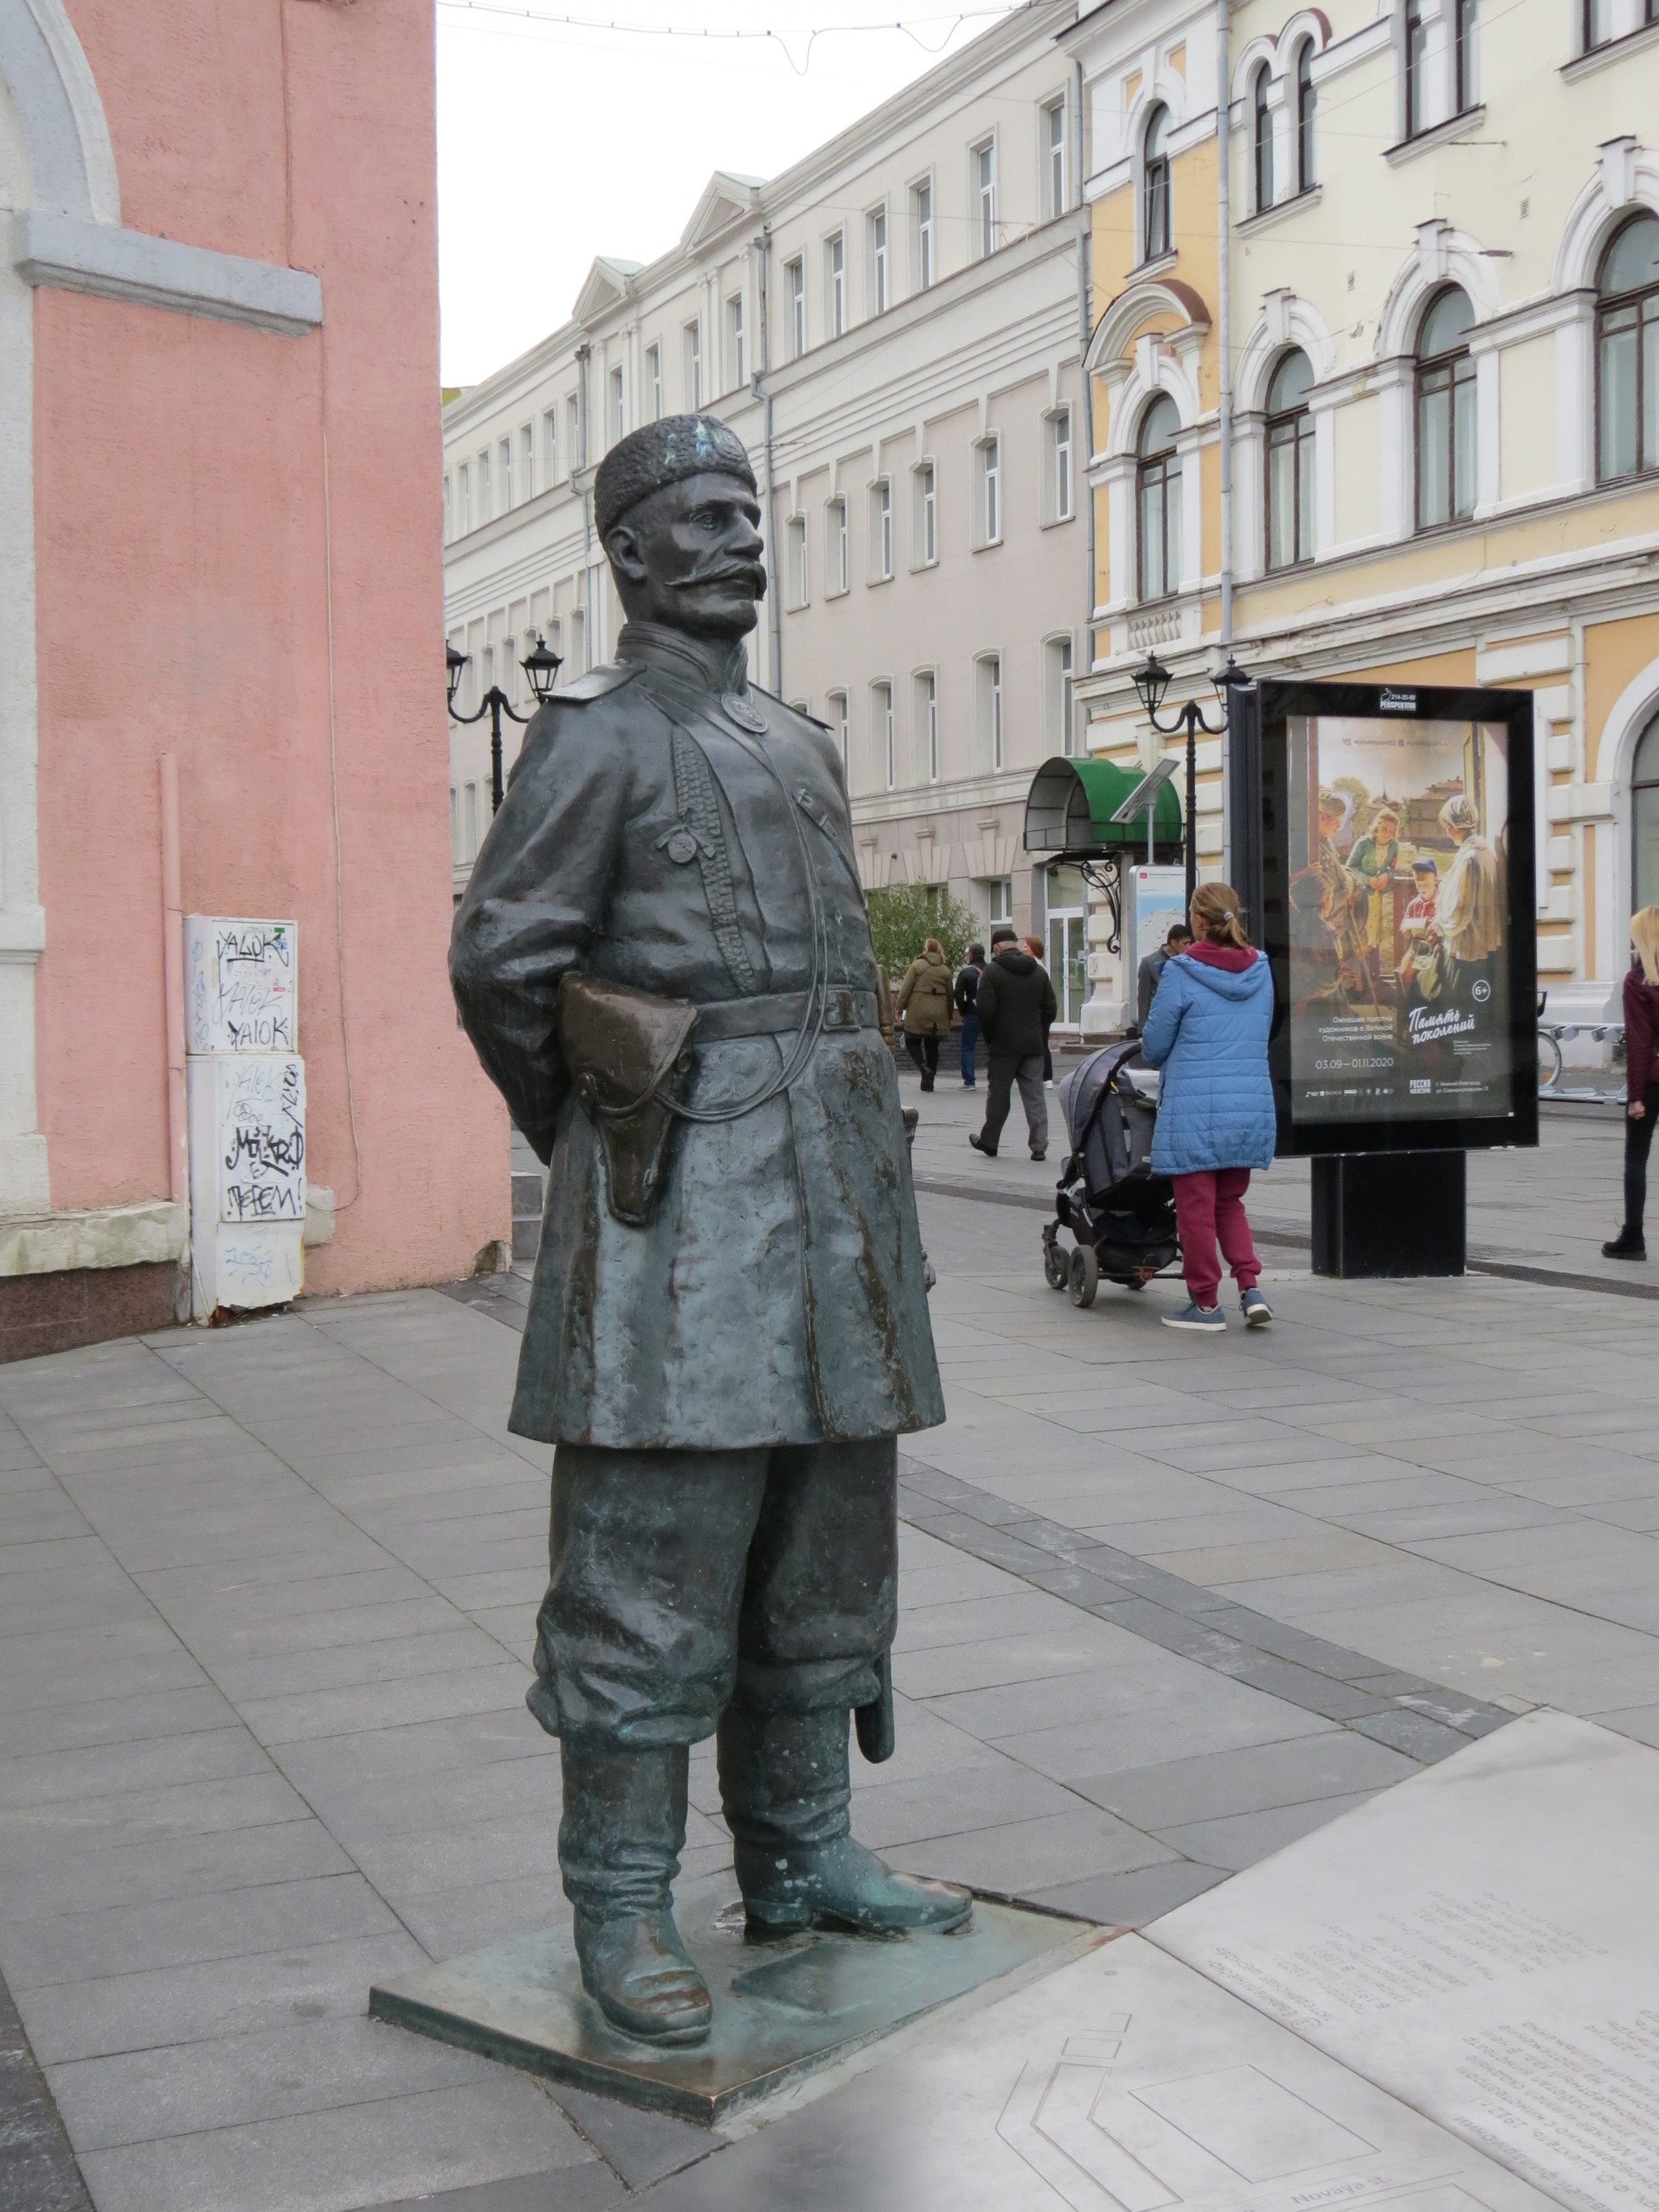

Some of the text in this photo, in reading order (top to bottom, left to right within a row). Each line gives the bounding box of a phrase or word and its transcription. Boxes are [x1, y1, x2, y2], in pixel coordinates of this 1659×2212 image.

[1318, 1025, 1358, 1034] художников
[1366, 1024, 1393, 1032] Великой
[1333, 1016, 1393, 1025] Ожившие полотна
[1409, 1007, 1461, 1033] Память
[1412, 1013, 1475, 1045] поколений
[1322, 1033, 1393, 1042] Отечественной войне
[1410, 1079, 1431, 1089] РОССИЯ
[1498, 2024, 1586, 2072] протяжение
[1583, 2024, 1637, 2052] другие
[1461, 2035, 1533, 2075] кинотеатр
[1520, 2053, 1552, 2069] зал.
[1465, 2055, 1527, 2089] сходные
[1454, 2066, 1546, 2120] кинотеатром
[1524, 2090, 1565, 2112] имел
[1529, 2076, 1592, 2110] работал
[1487, 2107, 1527, 2128] 1912
[1590, 2111, 1636, 2137] этаже
[1452, 2116, 1563, 2180] филармонии
[1525, 2128, 1597, 2170] Шехтель,
[1575, 2120, 1636, 2155] Москве
[1290, 2176, 1392, 2204] Novaya st.
